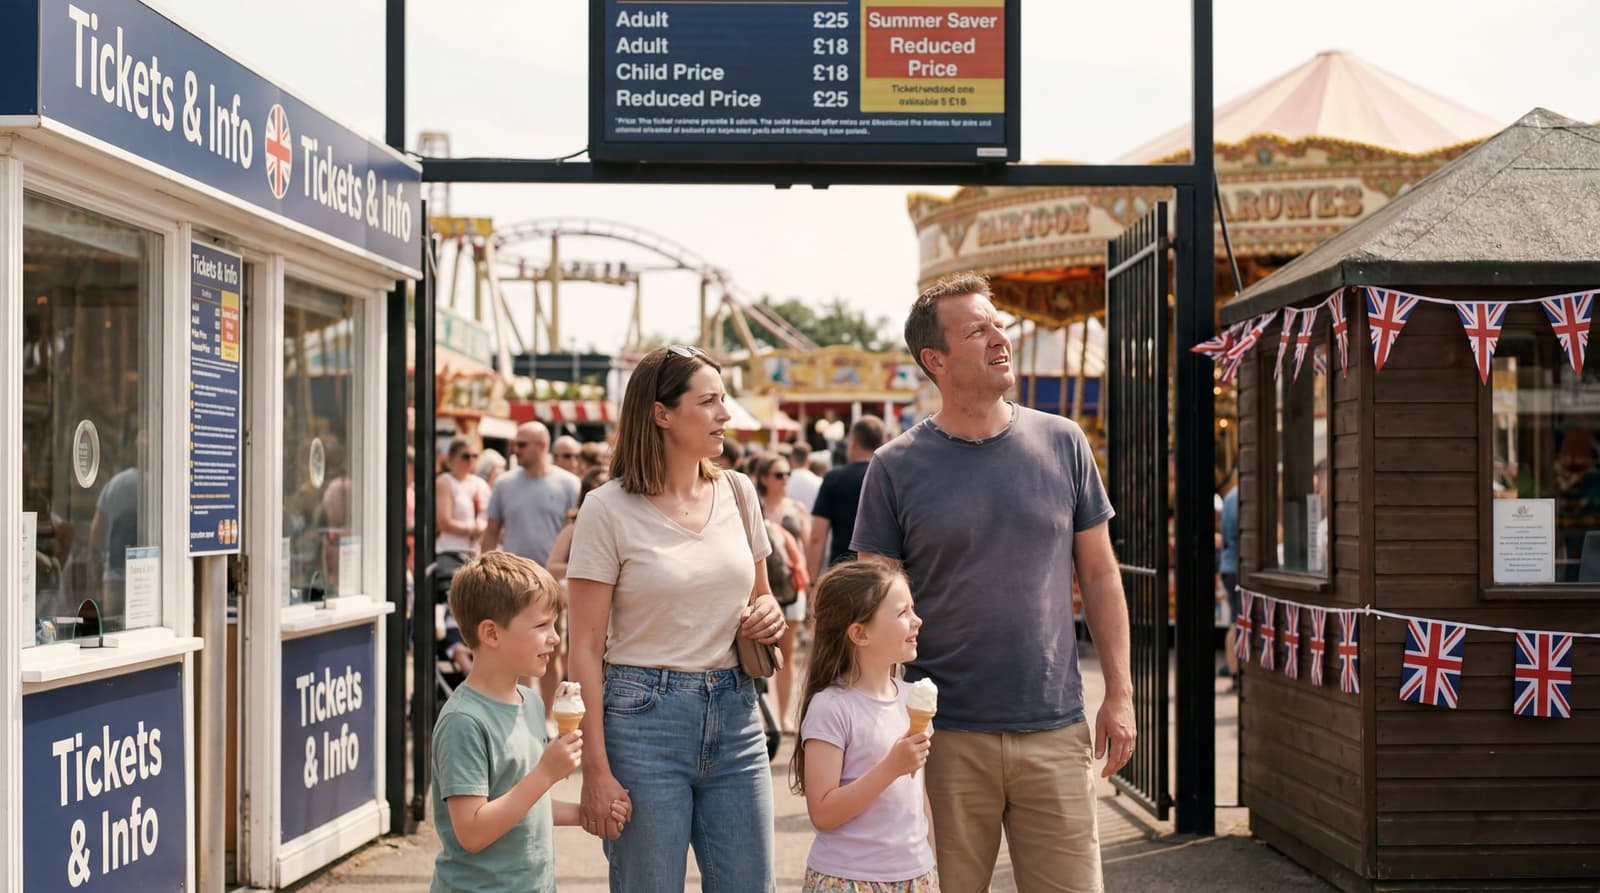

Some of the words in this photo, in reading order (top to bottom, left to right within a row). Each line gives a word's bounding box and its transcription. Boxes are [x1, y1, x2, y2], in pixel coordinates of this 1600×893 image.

[616, 10, 669, 28] Adult
[813, 12, 849, 28] £25
[869, 11, 943, 29] Summer
[947, 12, 998, 29] Saver
[616, 37, 669, 54] Adult
[813, 38, 849, 55] £18
[890, 37, 976, 54] Reduced
[616, 63, 668, 81] Child
[673, 64, 725, 81] Price
[813, 65, 849, 81] £18
[908, 60, 958, 77] Price
[69, 4, 174, 132] Tickets
[182, 70, 202, 146] &
[209, 84, 253, 169] Info
[616, 89, 705, 108] Reduced
[710, 90, 762, 108] Price
[813, 91, 849, 108] £25
[301, 135, 362, 221] Tickets
[365, 169, 379, 227] &
[382, 182, 411, 243] Info
[192, 253, 217, 279] Tickets
[224, 263, 238, 285] Info
[296, 666, 362, 727] Tickets
[52, 721, 162, 806] Tickets
[304, 736, 318, 789] &
[323, 723, 359, 783] Info
[68, 819, 91, 888] &
[102, 796, 159, 875] Info
